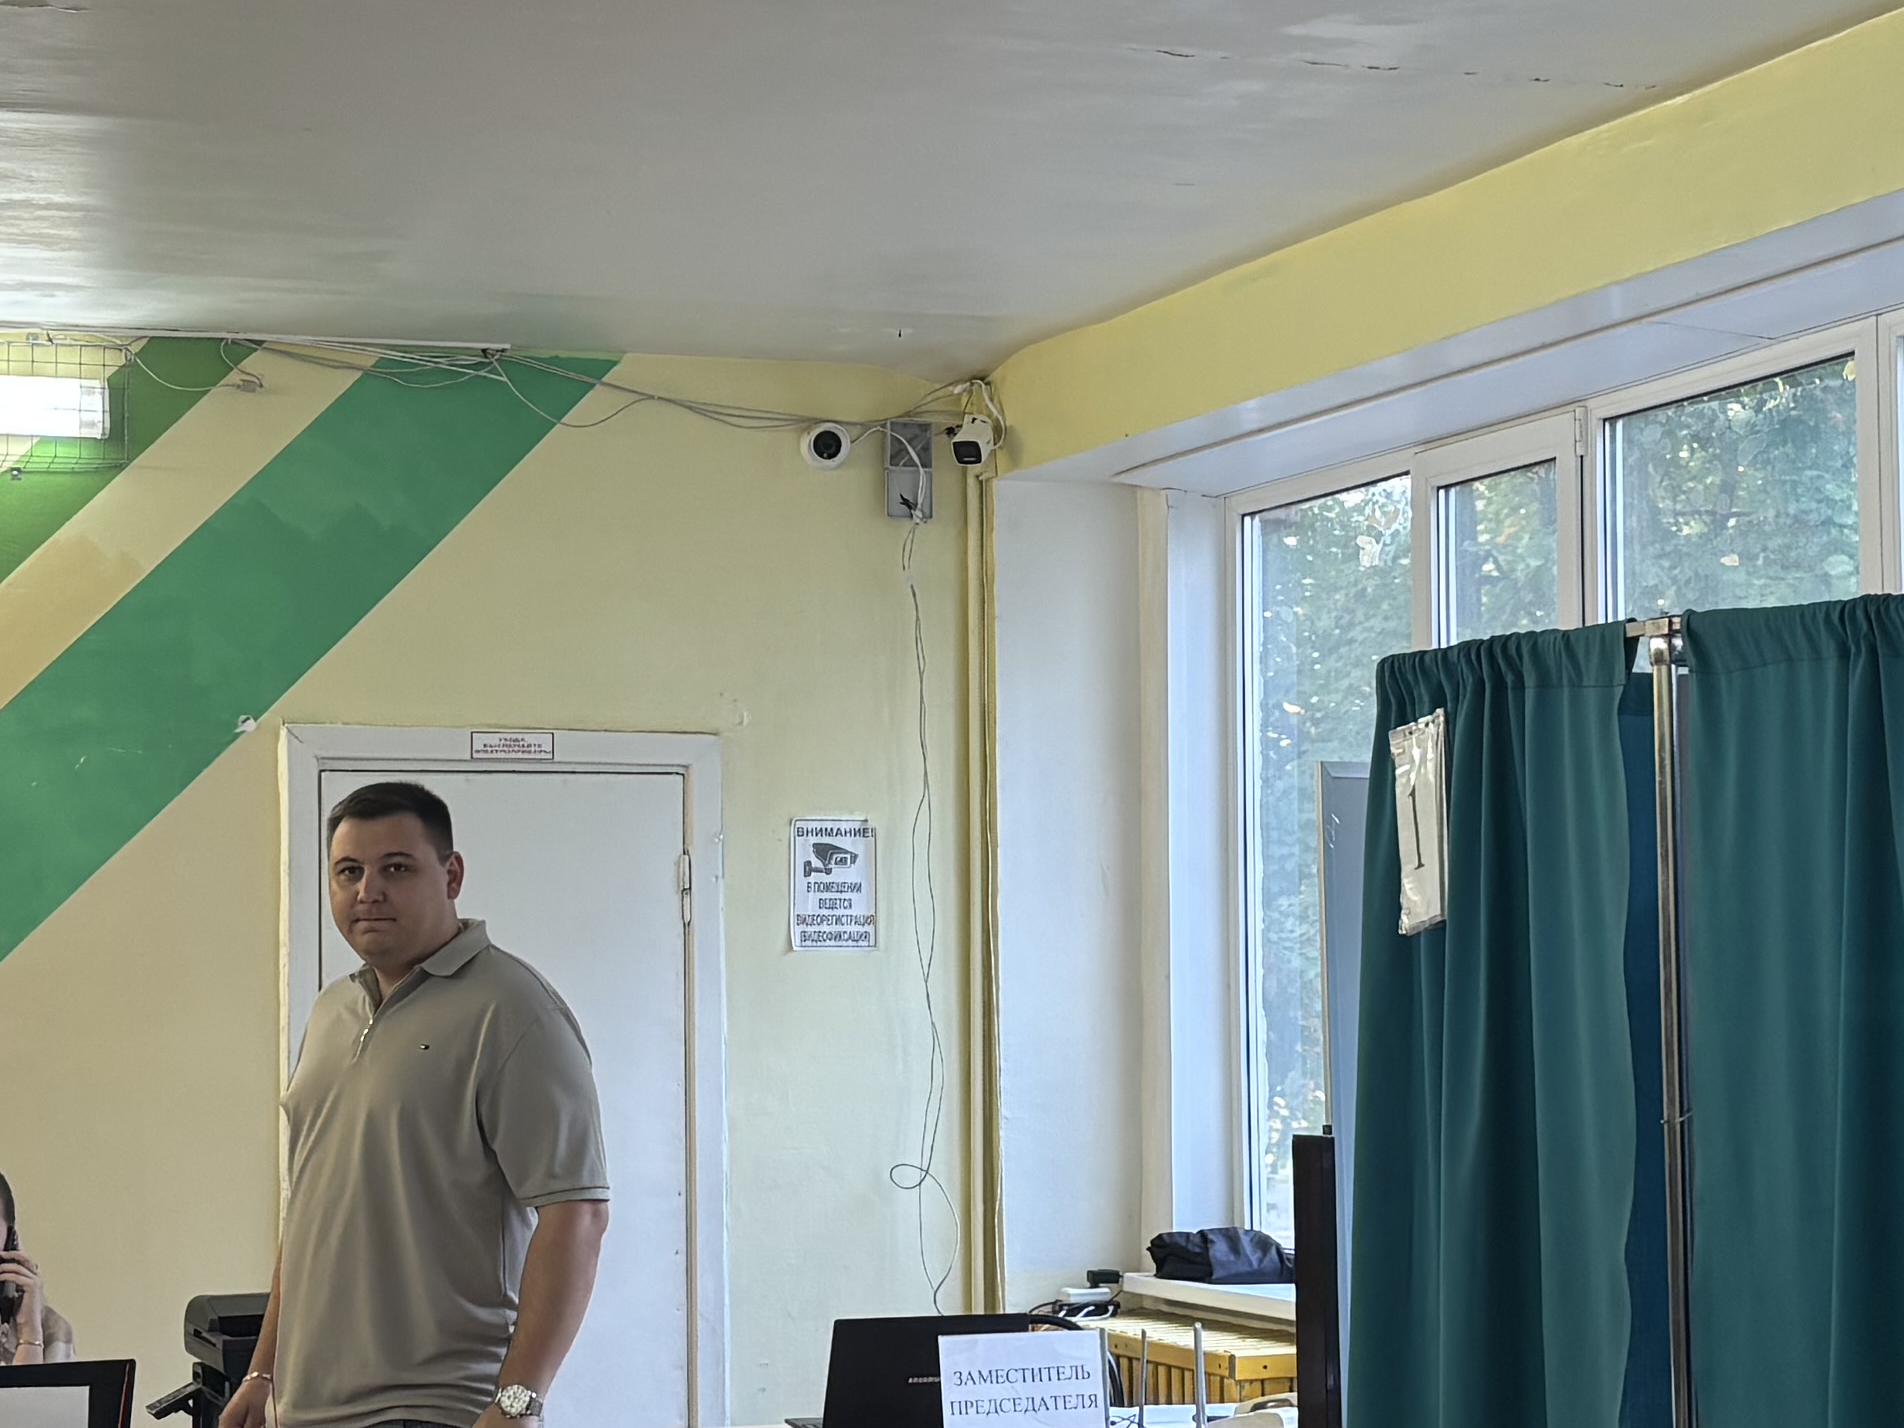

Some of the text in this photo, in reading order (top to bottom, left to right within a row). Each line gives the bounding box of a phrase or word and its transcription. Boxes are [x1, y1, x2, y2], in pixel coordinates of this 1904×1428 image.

[796, 826, 875, 839] ВНИМАНИЕ!
[1407, 785, 1426, 870] 1
[953, 1364, 1091, 1387] ЗАМЕСТИТЕЛЬ
[949, 1393, 1099, 1417] ПРЕДСЕДАТЕЛЯ
